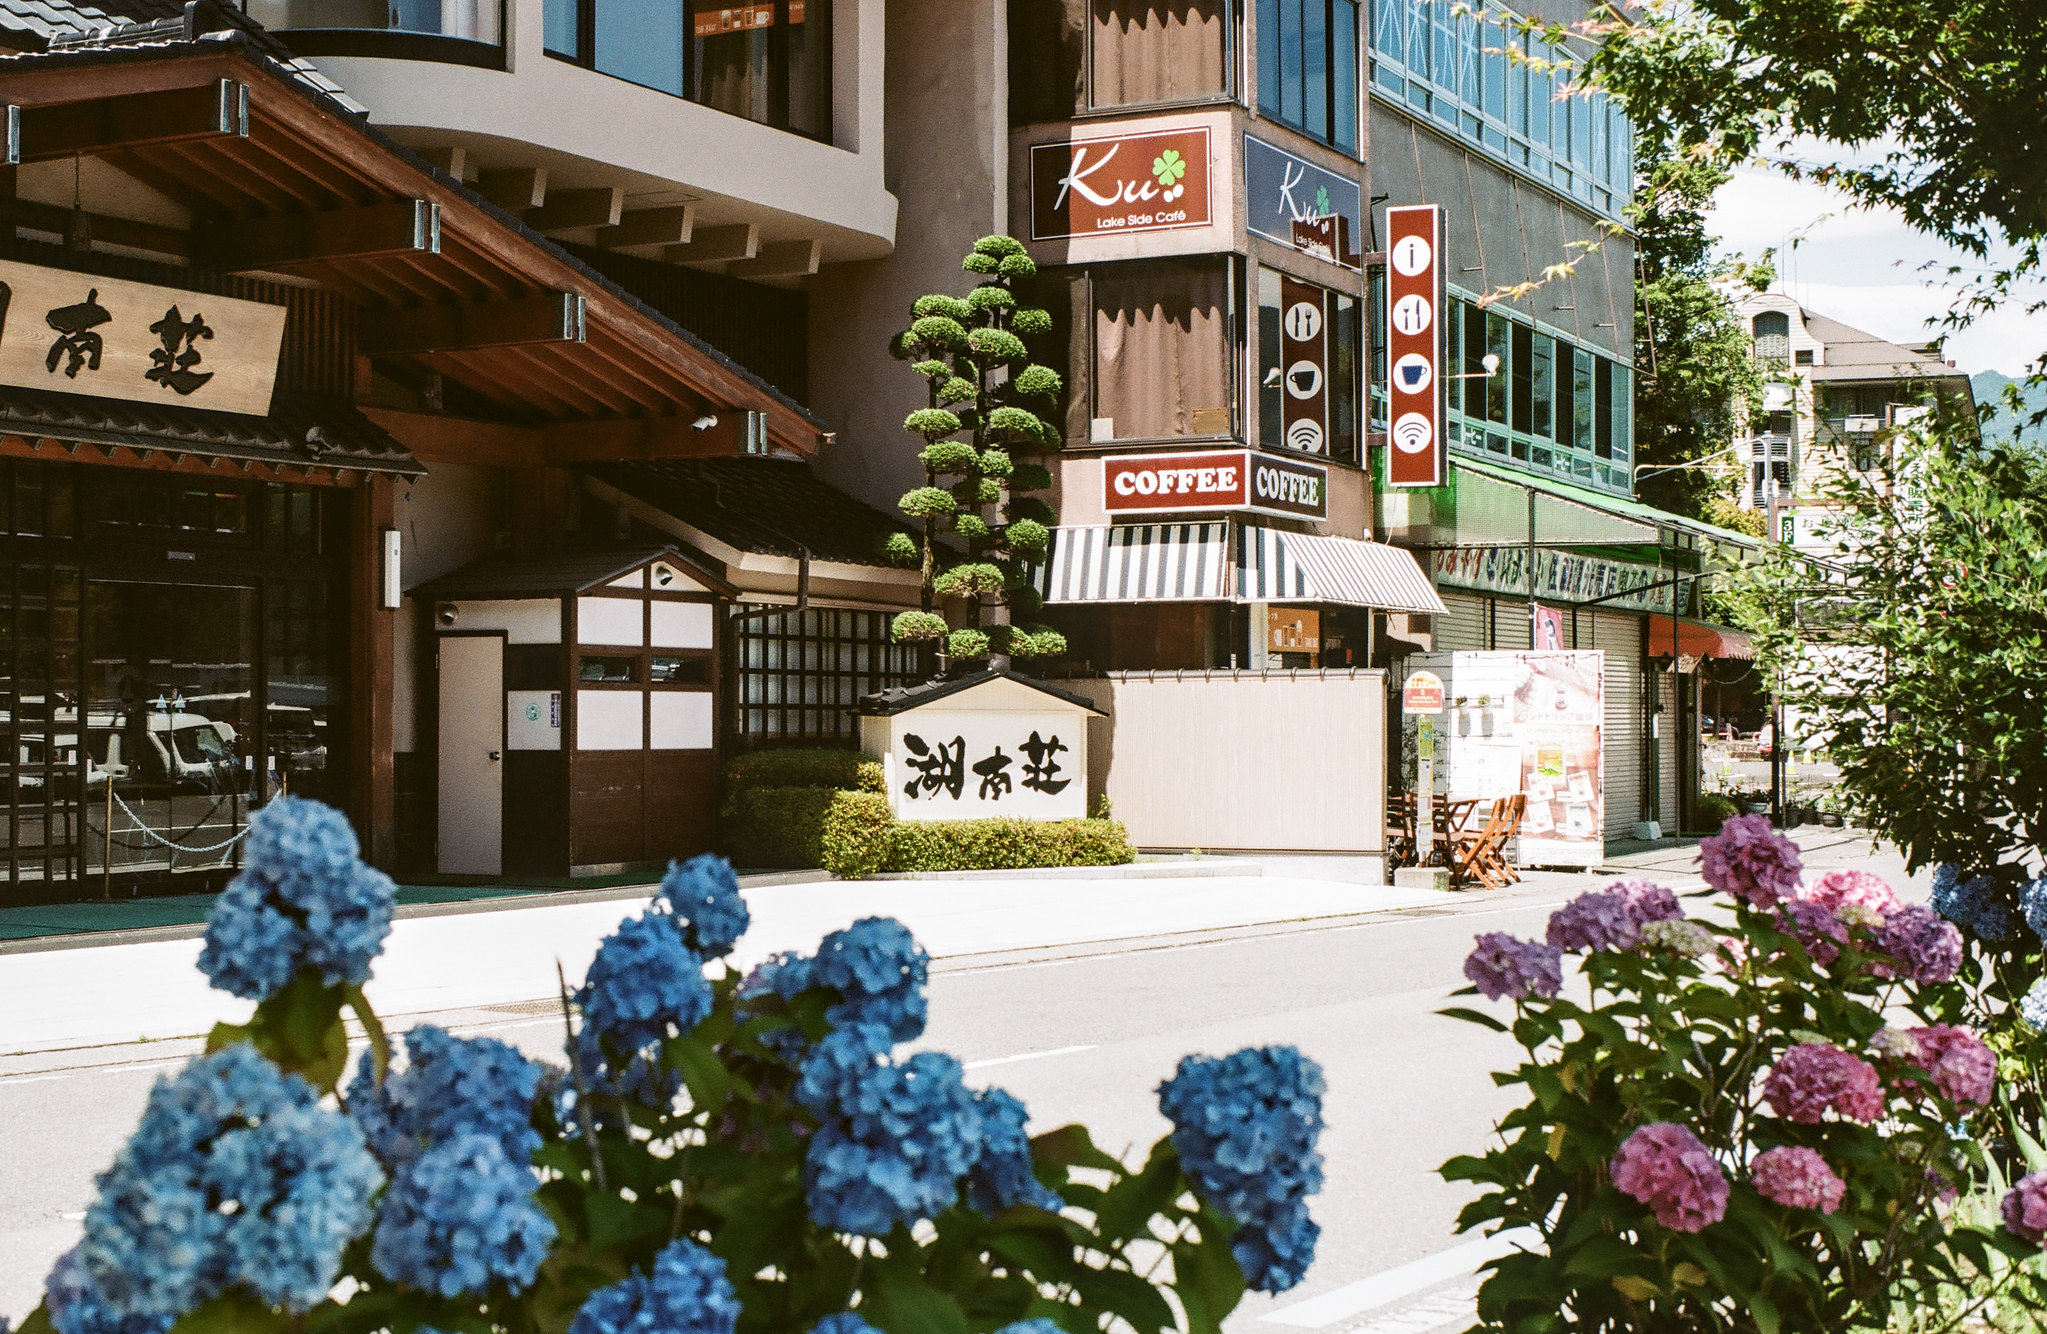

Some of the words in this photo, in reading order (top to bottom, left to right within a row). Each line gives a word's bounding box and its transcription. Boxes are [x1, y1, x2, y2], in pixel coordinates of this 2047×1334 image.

[1097, 217, 1125, 229] Lake
[1128, 213, 1153, 226] Side
[1155, 209, 1186, 223] Café
[0, 281, 214, 395] 南荘
[1114, 466, 1238, 496] COFFEE
[1256, 466, 1319, 507] COFFEE
[903, 730, 1072, 801] 湖南荘
